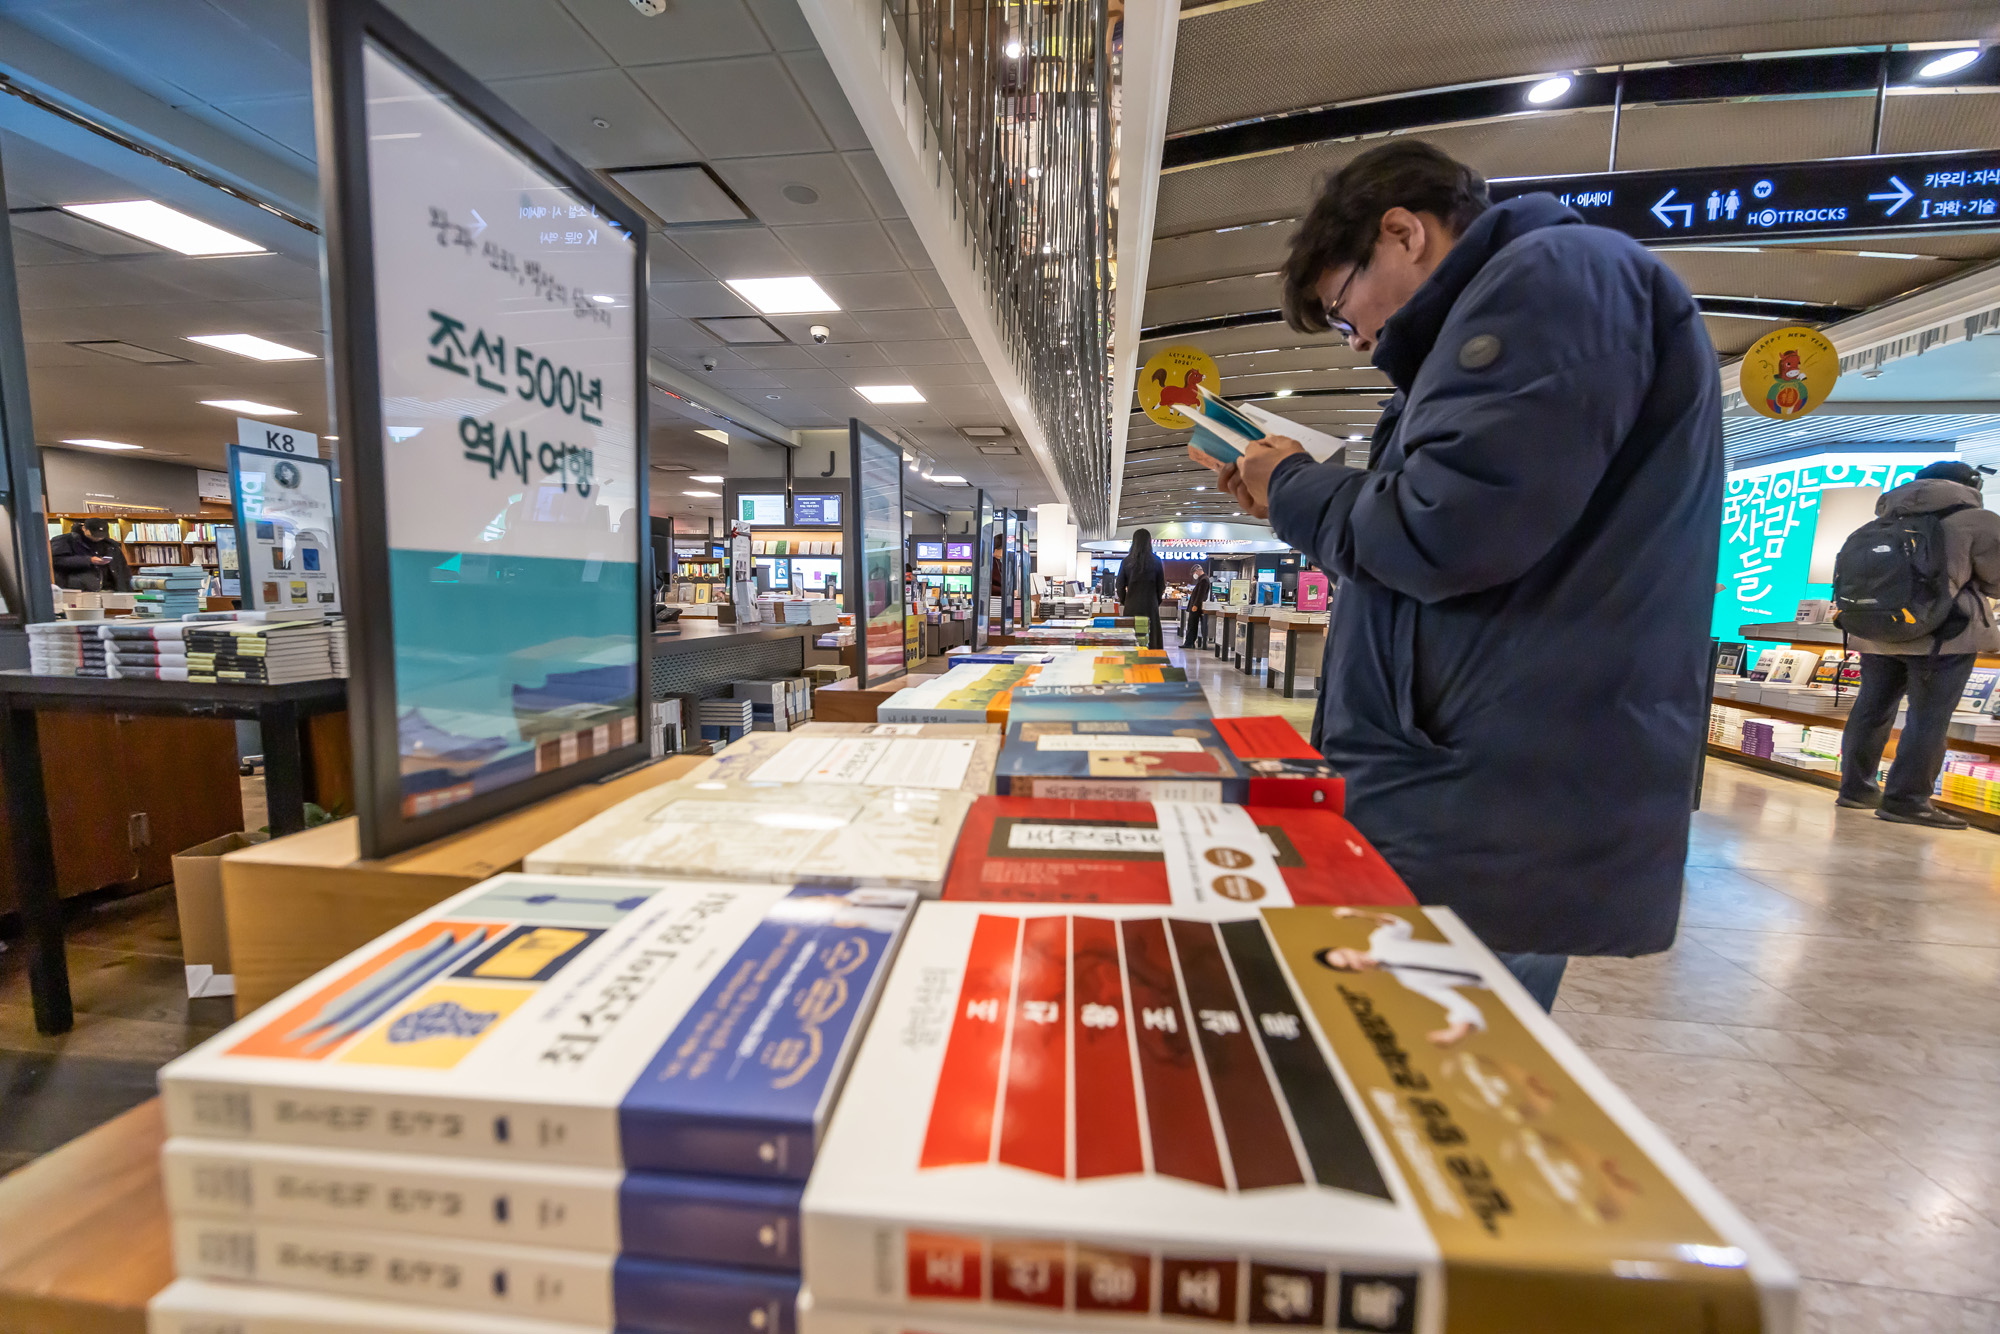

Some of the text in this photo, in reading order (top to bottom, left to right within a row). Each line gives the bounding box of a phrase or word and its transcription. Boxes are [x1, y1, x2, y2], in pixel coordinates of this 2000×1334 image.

[1748, 207, 1847, 227] HOTTRACKS
[428, 308, 603, 427] 조선 500년
[266, 430, 295, 453] K8
[459, 415, 594, 498] 역사 여행
[821, 451, 835, 477] J
[1722, 468, 1820, 525] 움직이는
[961, 520, 970, 534] J
[1729, 501, 1800, 558] 사람
[1733, 547, 1773, 602] 들
